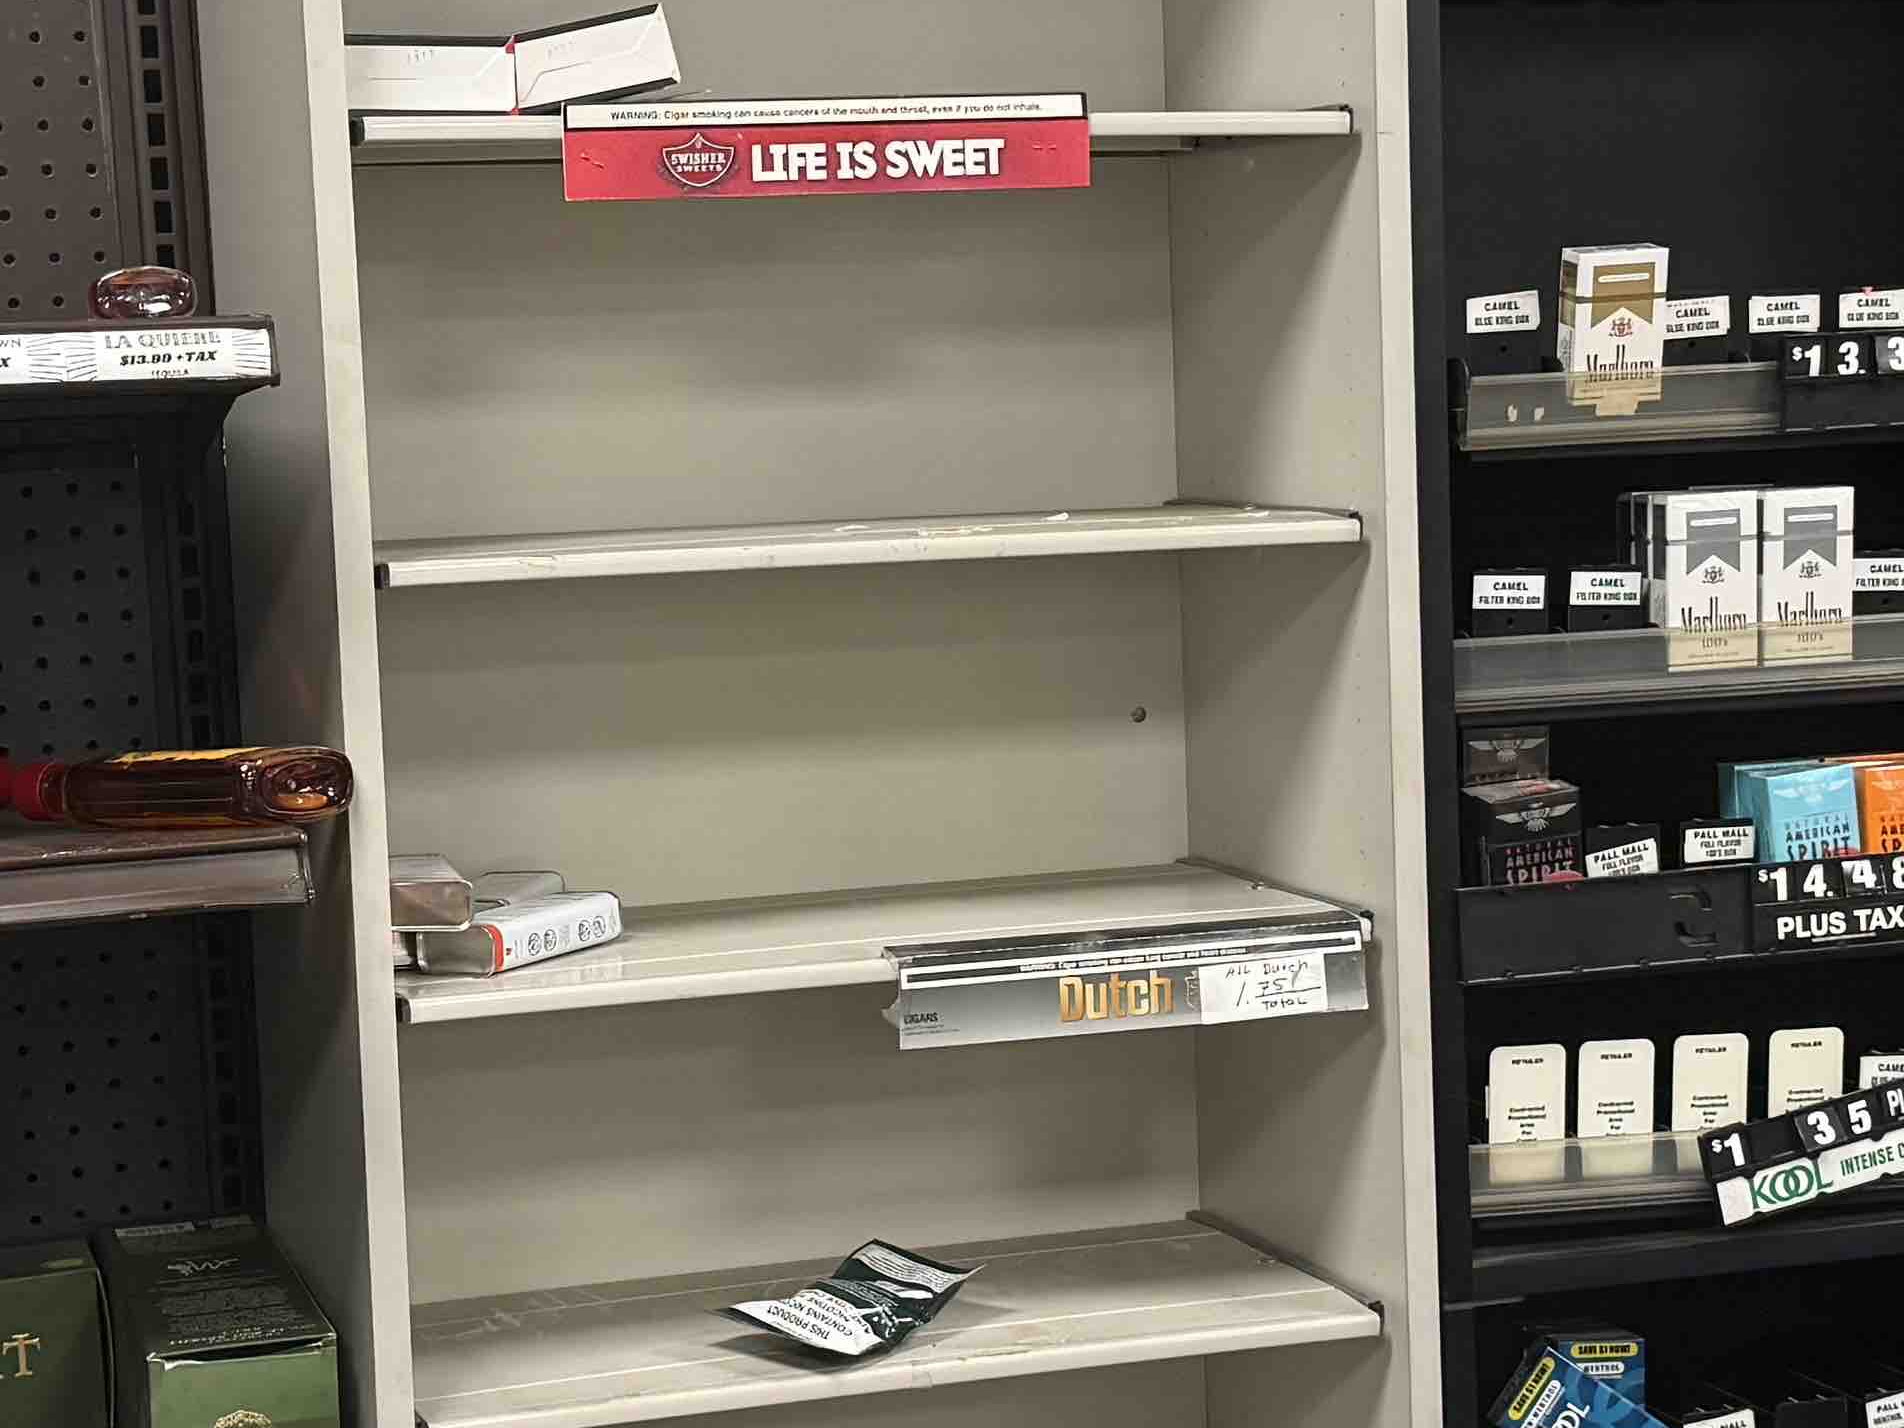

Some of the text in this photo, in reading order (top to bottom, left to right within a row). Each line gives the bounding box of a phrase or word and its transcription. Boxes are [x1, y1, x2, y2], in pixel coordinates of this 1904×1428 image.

[752, 138, 1004, 182] LIFE IS SWEET
[1786, 822, 1850, 844] AMERICAN
[1777, 911, 1846, 940] PLUS
[1060, 970, 1176, 1024] Dutch
[1749, 1160, 1833, 1208] KOOL
[1841, 1146, 1895, 1176] INTENSE
